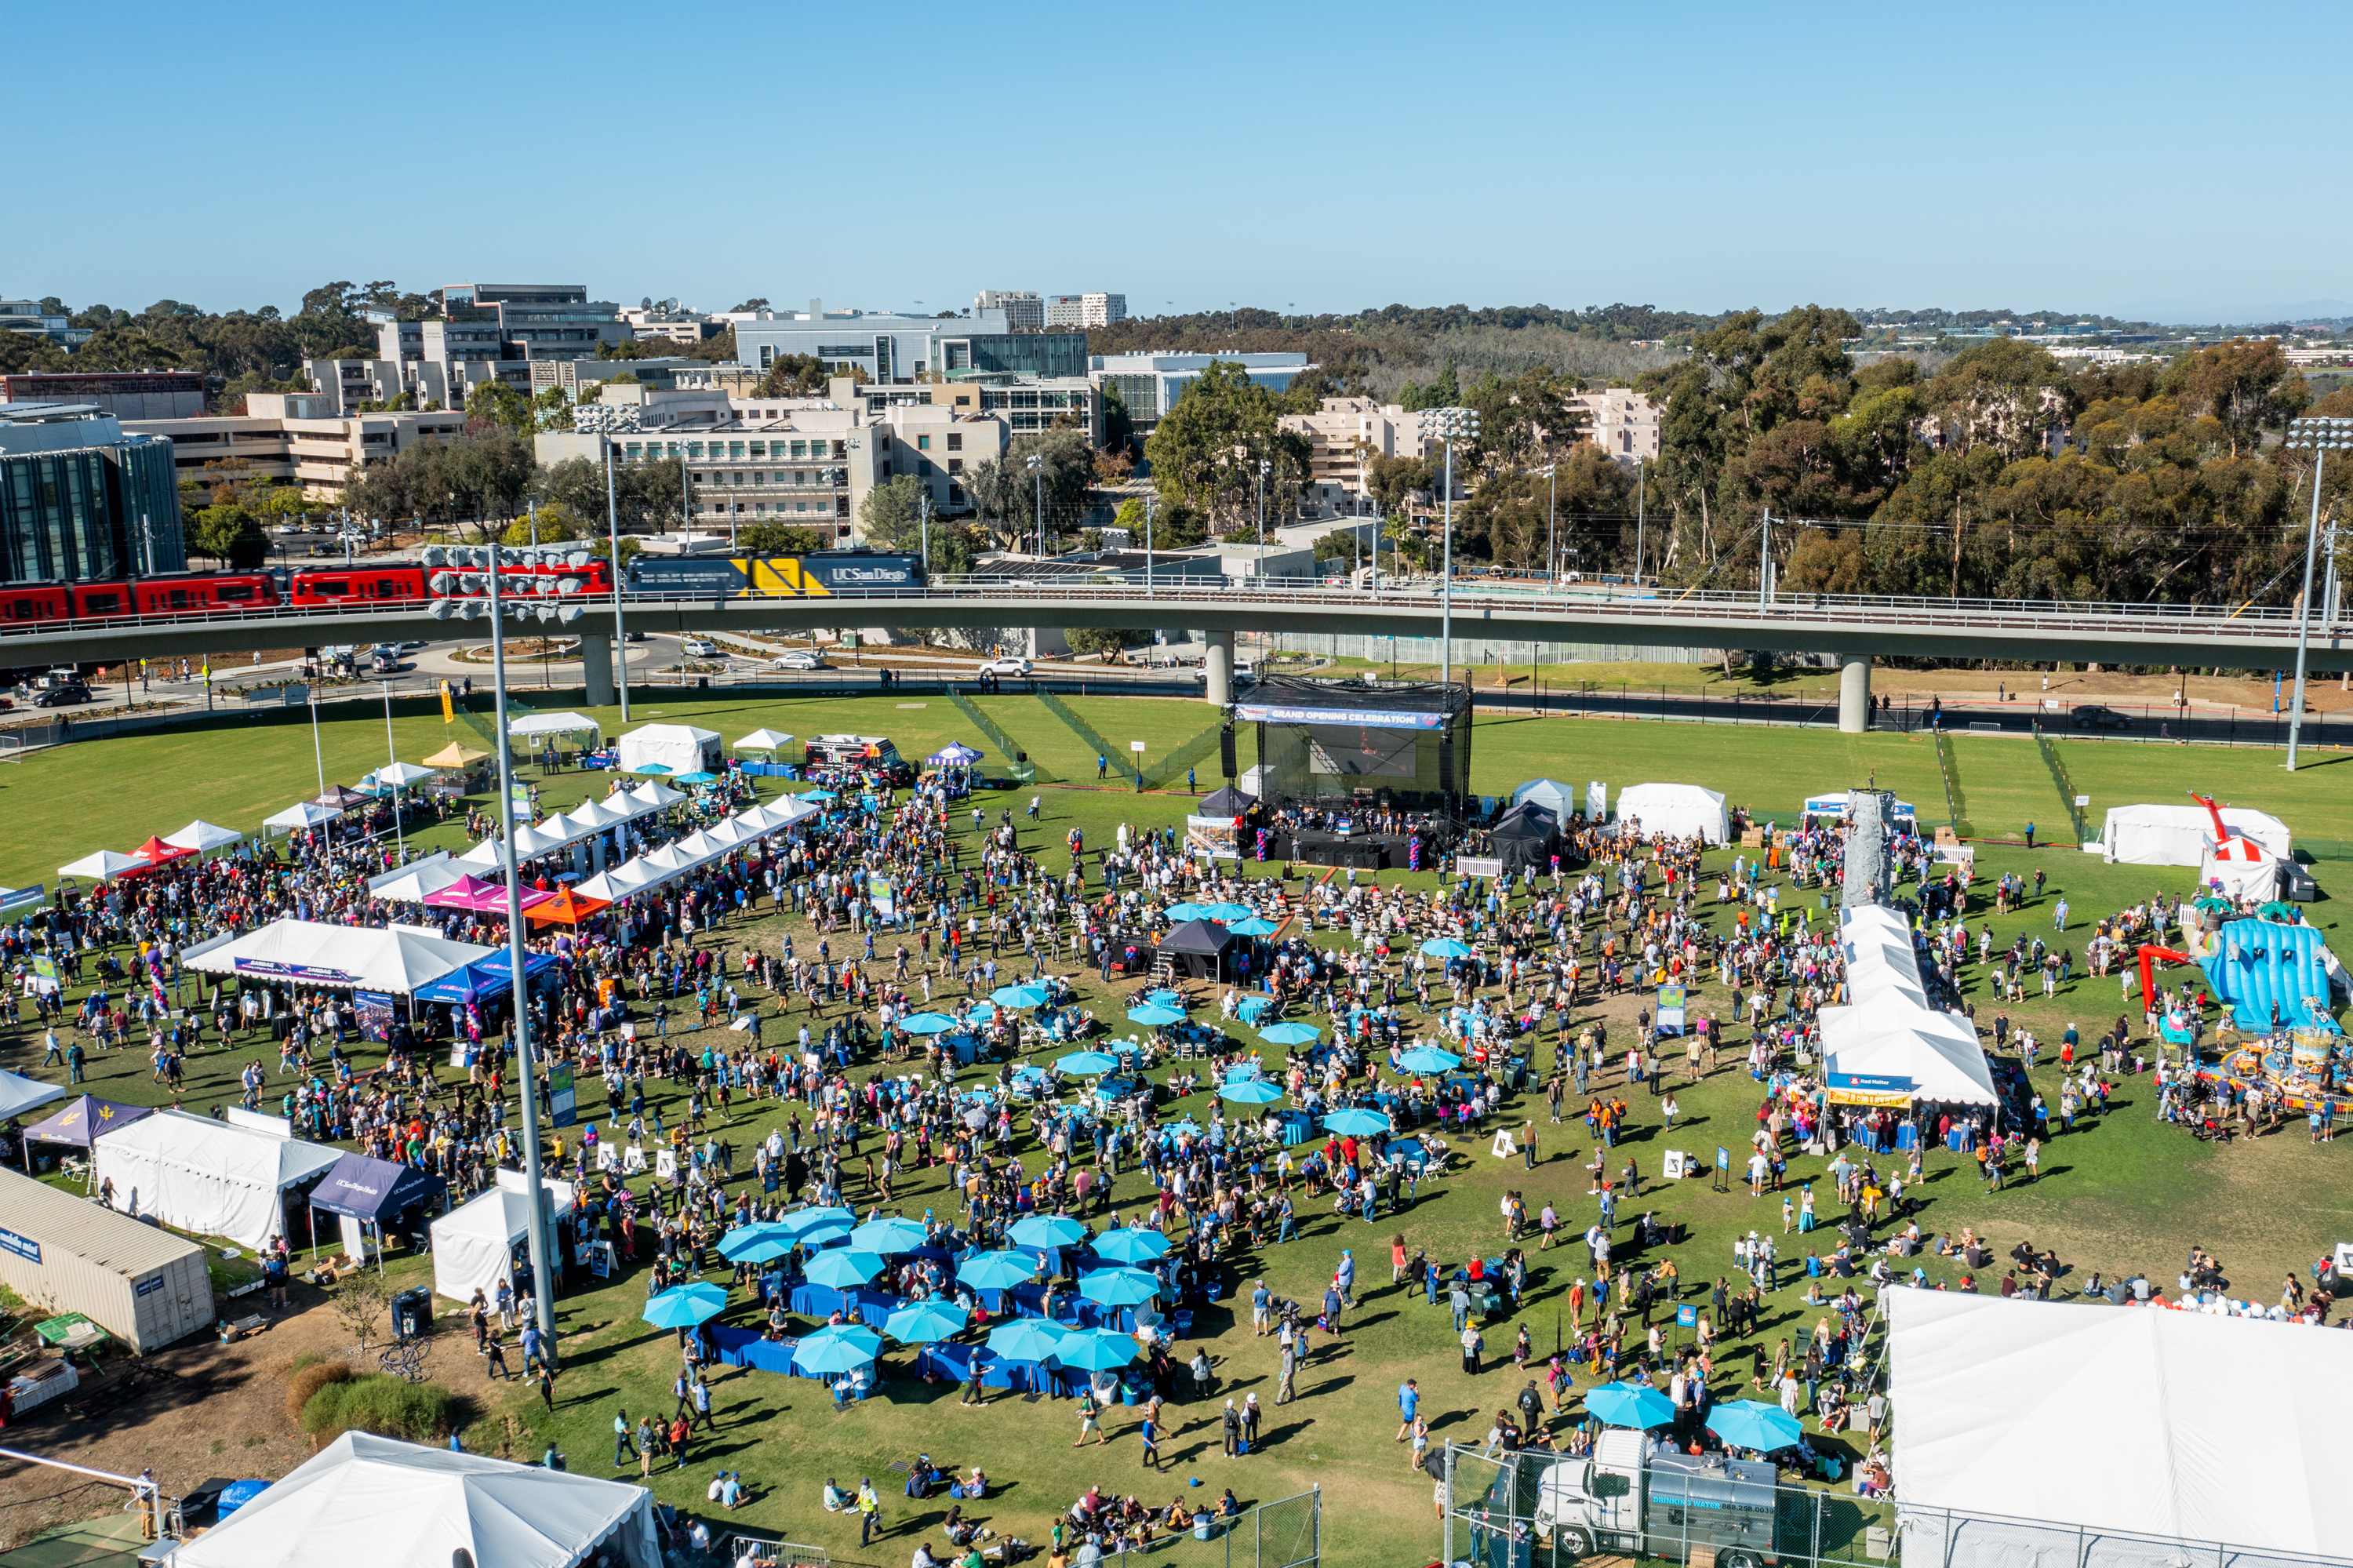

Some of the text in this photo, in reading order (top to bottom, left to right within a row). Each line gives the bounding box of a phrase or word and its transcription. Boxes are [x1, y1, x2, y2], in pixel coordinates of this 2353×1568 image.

[1272, 710, 1304, 719] GRAND
[1306, 711, 1347, 721] OPENING
[1348, 713, 1417, 724] CELEBRATION!
[362, 1185, 378, 1195] Health
[0, 1232, 23, 1249] mobile
[22, 1242, 38, 1255] mini
[1653, 1496, 1774, 1514] DRINKING WATER 888.258.0039
